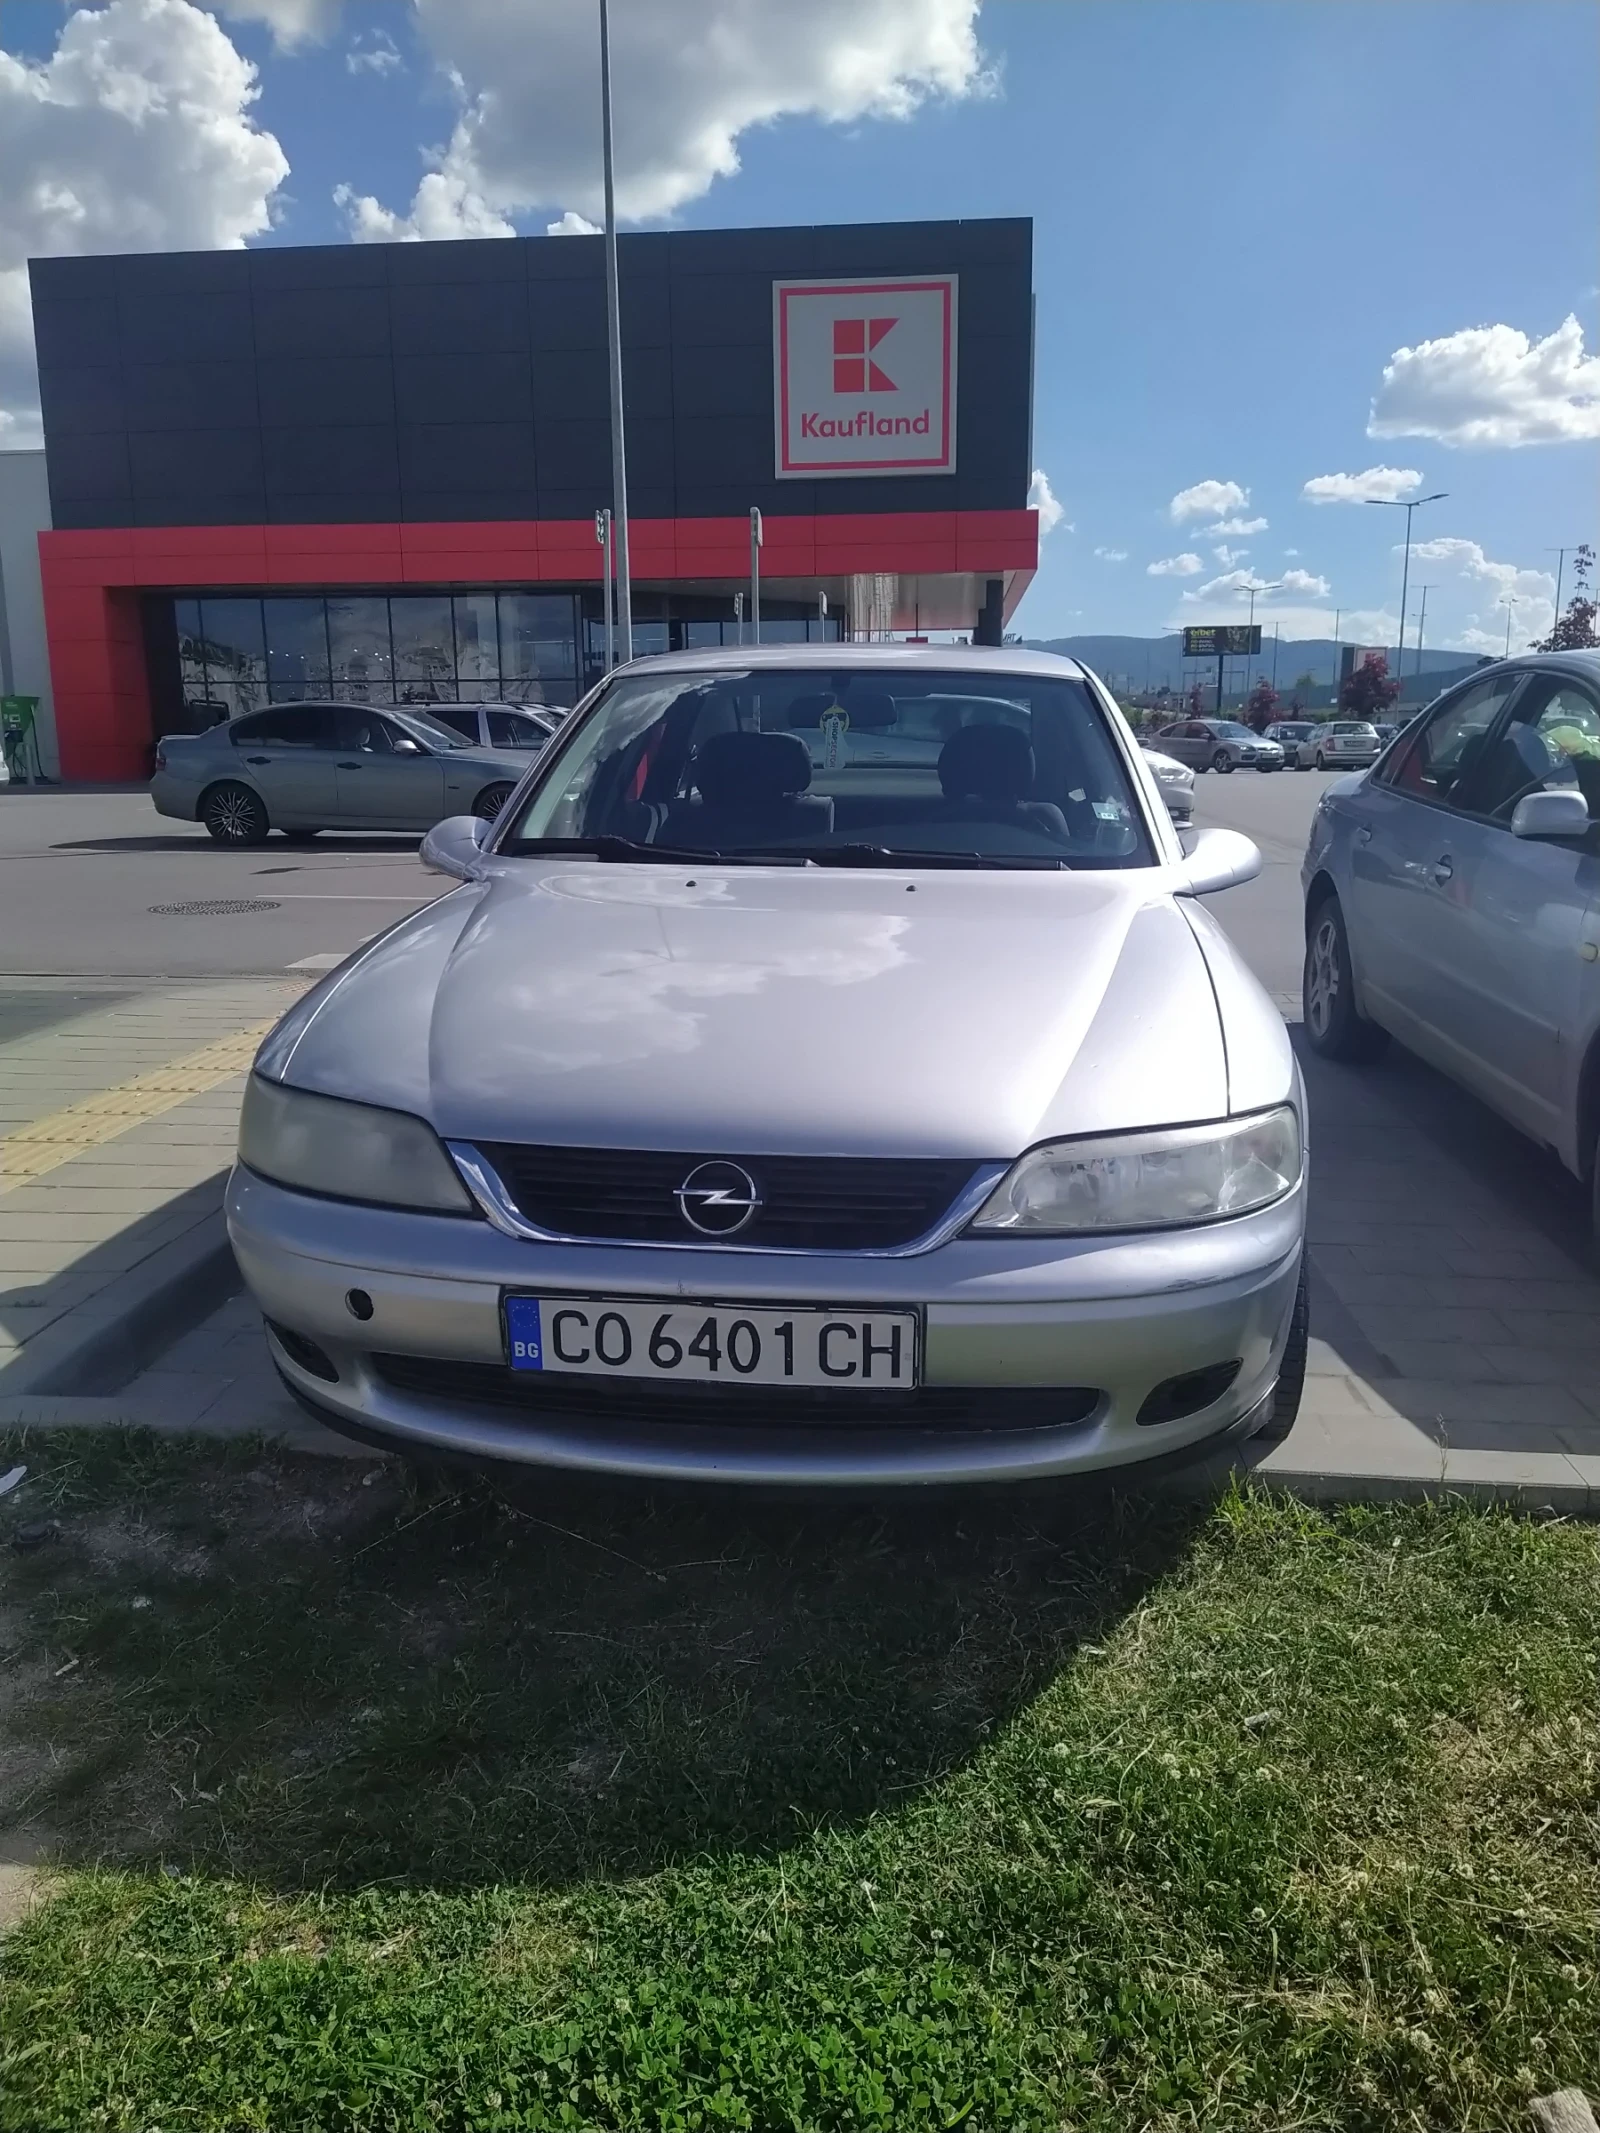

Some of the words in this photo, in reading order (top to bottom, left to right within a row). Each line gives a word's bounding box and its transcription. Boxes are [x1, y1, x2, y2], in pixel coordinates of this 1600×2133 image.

[801, 408, 930, 438] Kaufland
[514, 1341, 539, 1359] BG
[552, 1309, 632, 1366] CO
[649, 1313, 794, 1376] 6401
[819, 1322, 901, 1379] CH
